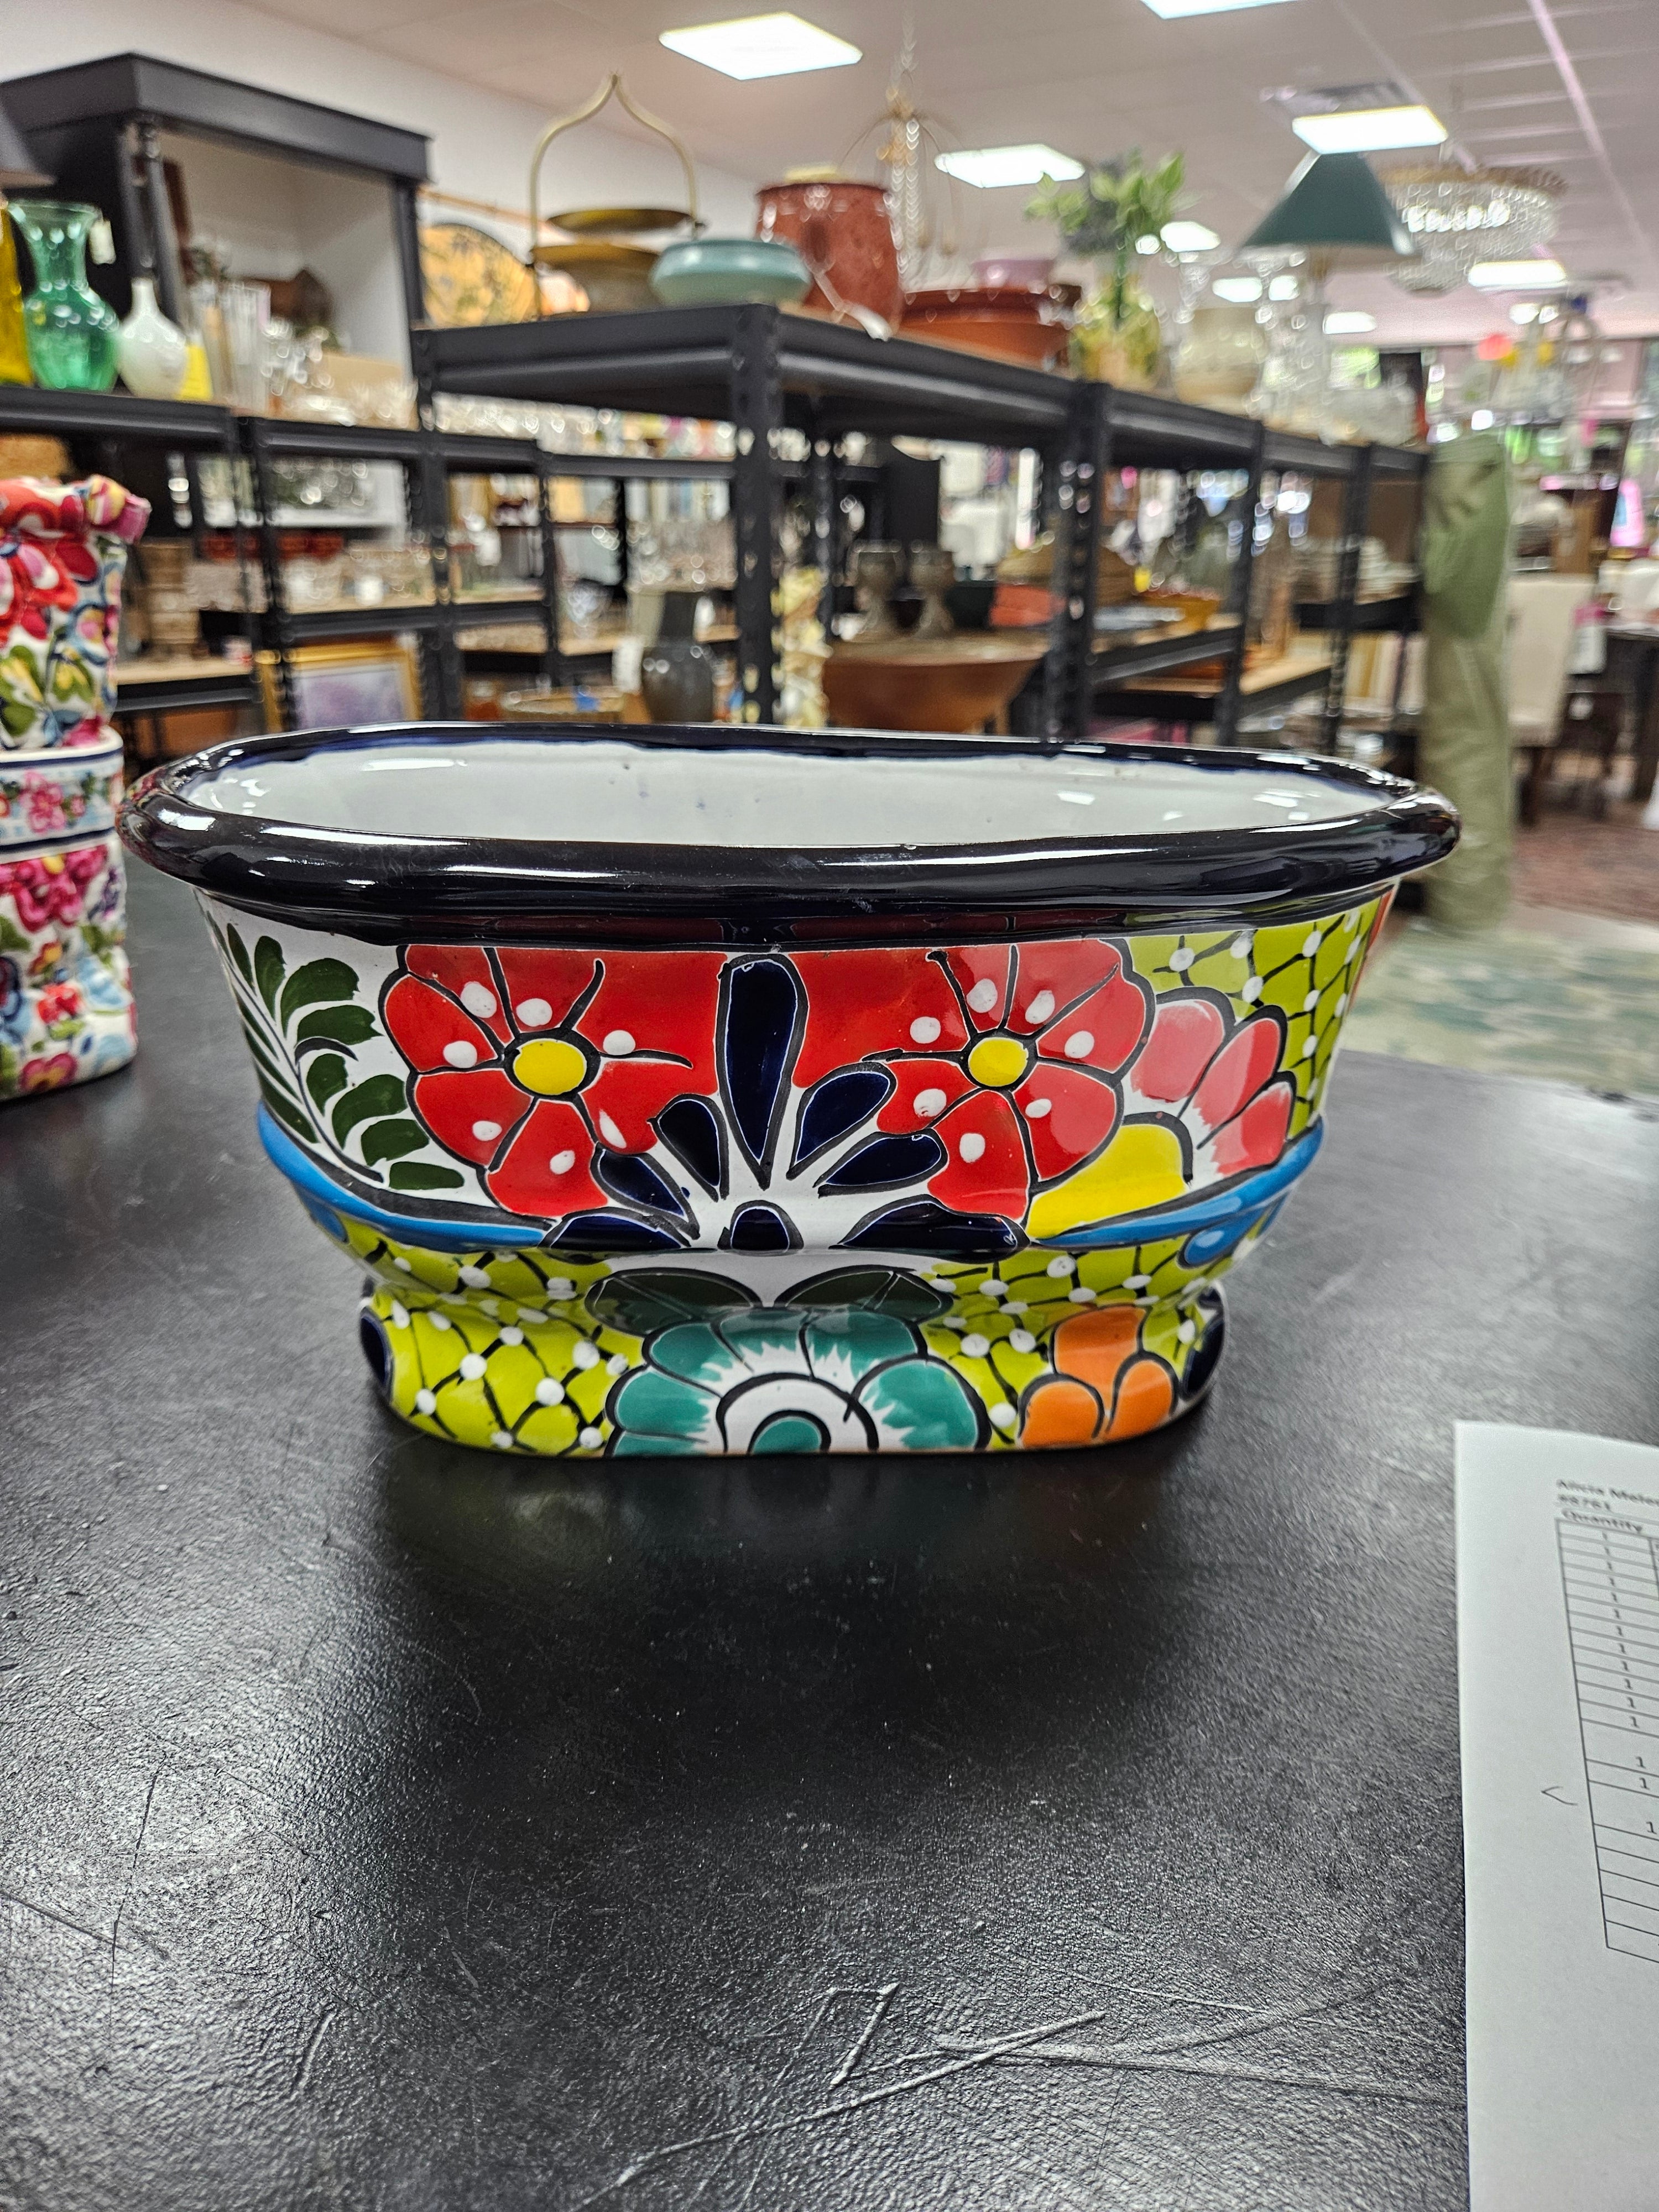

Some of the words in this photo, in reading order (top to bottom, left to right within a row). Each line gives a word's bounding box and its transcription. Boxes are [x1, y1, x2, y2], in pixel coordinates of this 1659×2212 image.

[1561, 1508, 1643, 1533] Quantity
[1613, 1608, 1621, 1619] 1
[1616, 1625, 1624, 1637] 1
[1618, 1643, 1627, 1655] 1
[1621, 1660, 1630, 1672] 1
[1624, 1678, 1633, 1691] 1
[1626, 1697, 1637, 1709] 1
[1629, 1716, 1640, 1729] 1
[1635, 1756, 1647, 1769] 1
[1639, 1777, 1650, 1791] 1
[1646, 1821, 1657, 1835] 1
